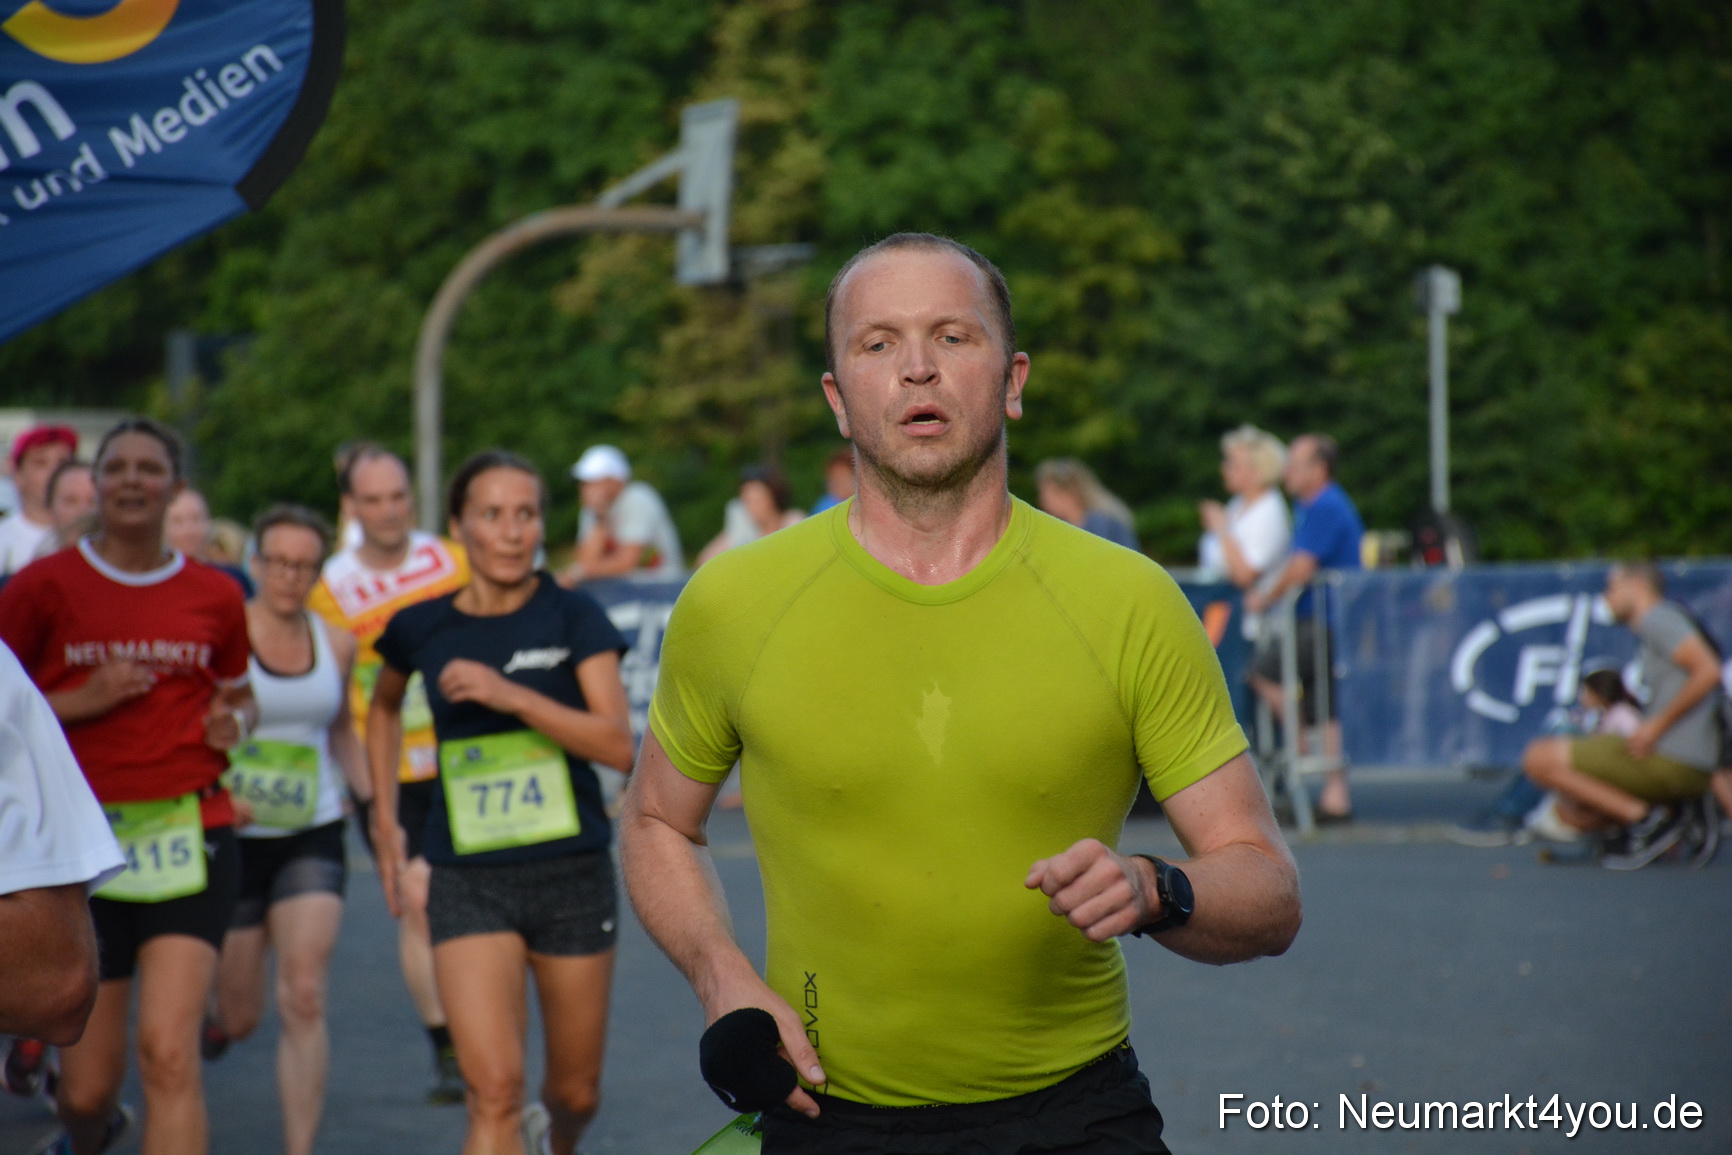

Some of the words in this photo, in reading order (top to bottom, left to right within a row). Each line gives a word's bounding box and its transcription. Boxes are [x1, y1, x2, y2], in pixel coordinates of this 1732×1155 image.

[12, 142, 108, 210] und
[108, 44, 284, 168] Medien
[470, 774, 545, 818] 774
[126, 836, 191, 873] 415
